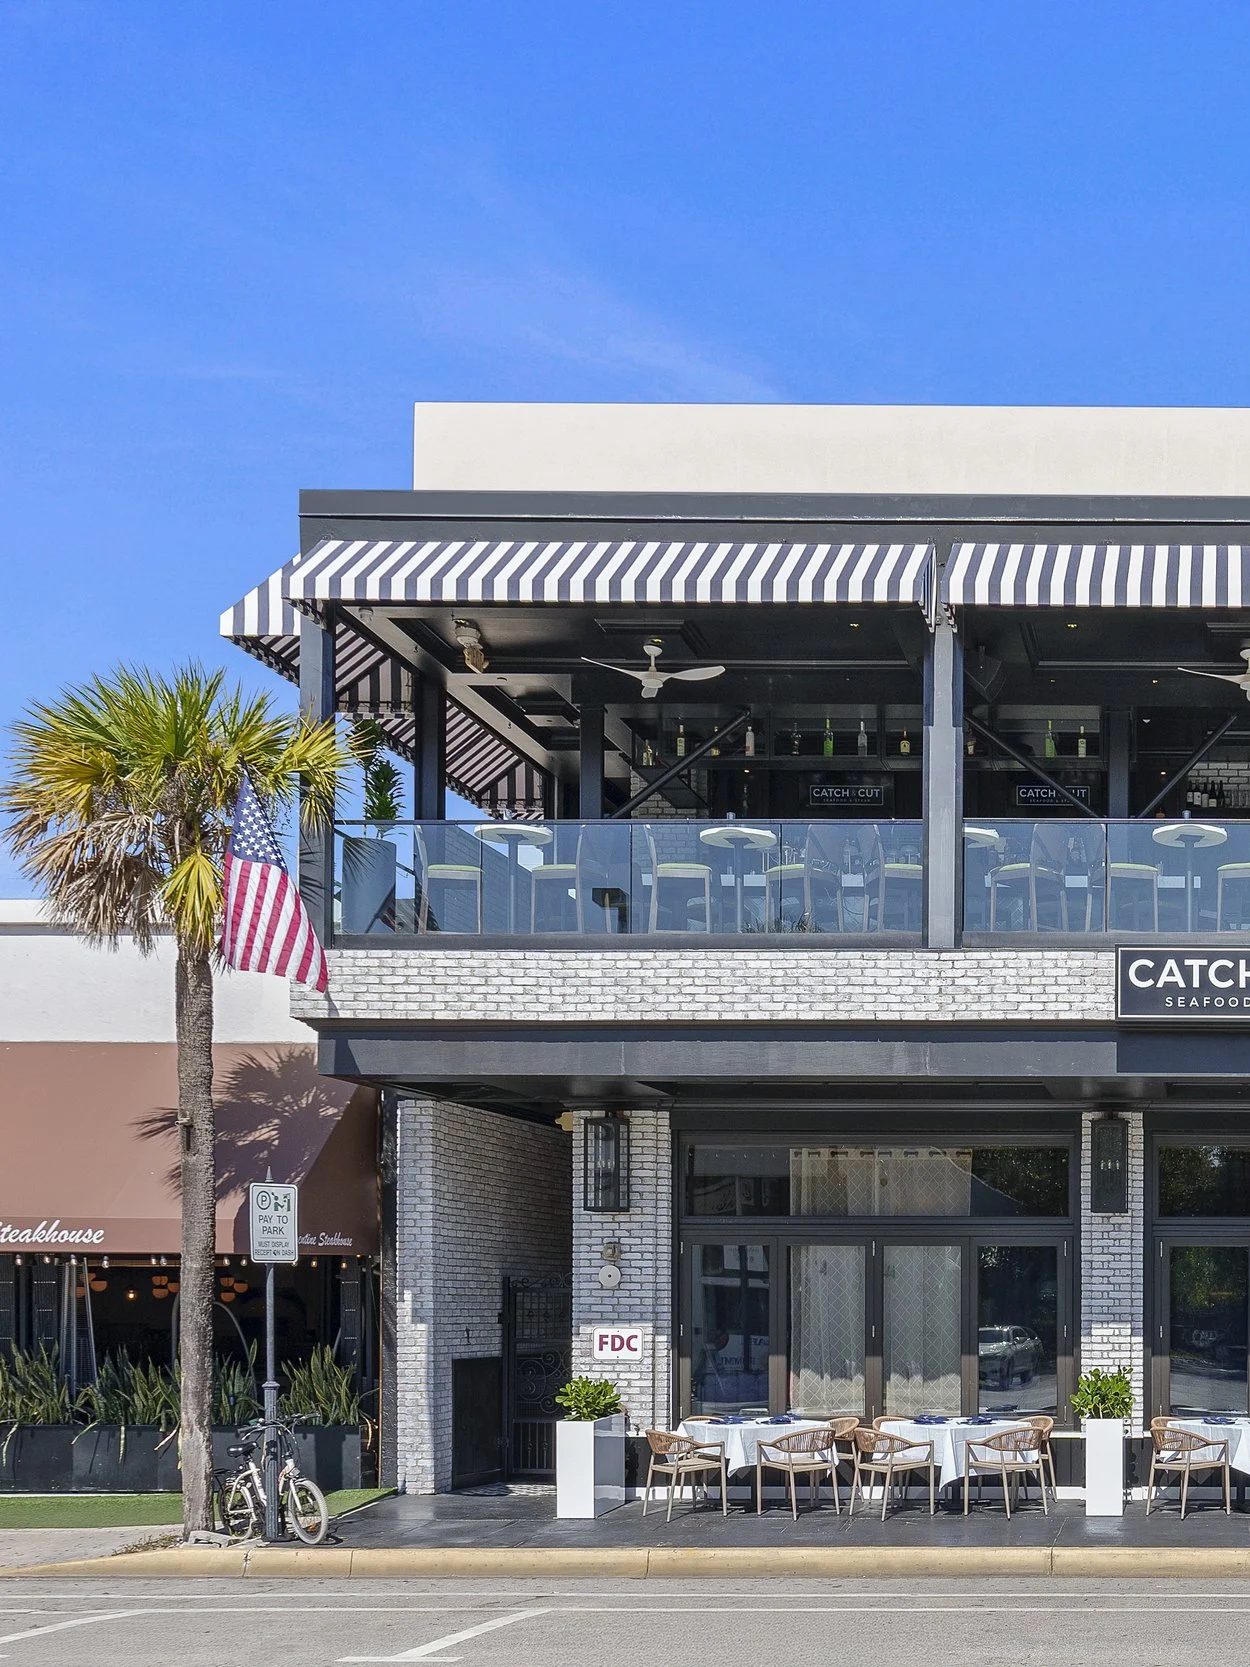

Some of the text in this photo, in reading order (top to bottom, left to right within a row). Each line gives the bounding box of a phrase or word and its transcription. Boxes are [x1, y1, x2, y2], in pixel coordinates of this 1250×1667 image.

[812, 788, 850, 798] CATCH
[857, 788, 880, 798] CUT
[1019, 788, 1056, 798] CATCH
[258, 1214, 289, 1225] PAY TO
[262, 1226, 285, 1235] PARK
[598, 1334, 638, 1352] FDC
